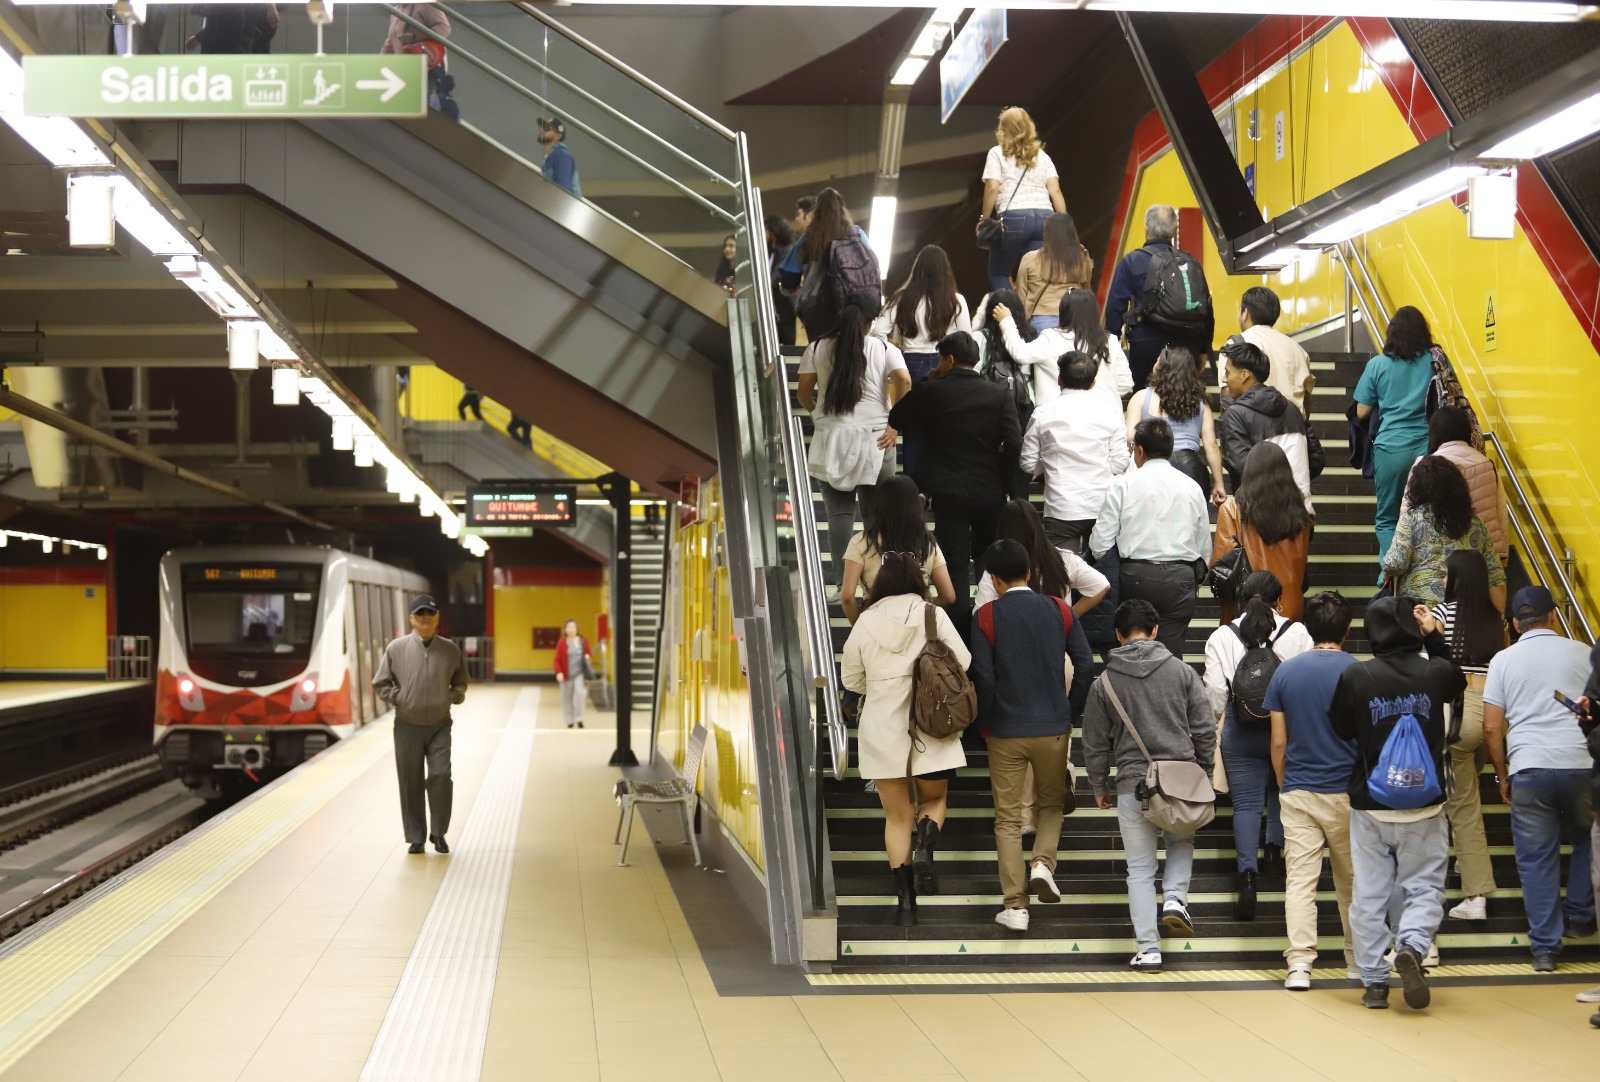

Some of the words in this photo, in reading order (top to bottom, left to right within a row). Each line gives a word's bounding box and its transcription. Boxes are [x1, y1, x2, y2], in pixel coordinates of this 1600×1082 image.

[101, 67, 233, 103] Salida
[488, 502, 538, 512] QUITUMBE
[556, 502, 565, 512] 4
